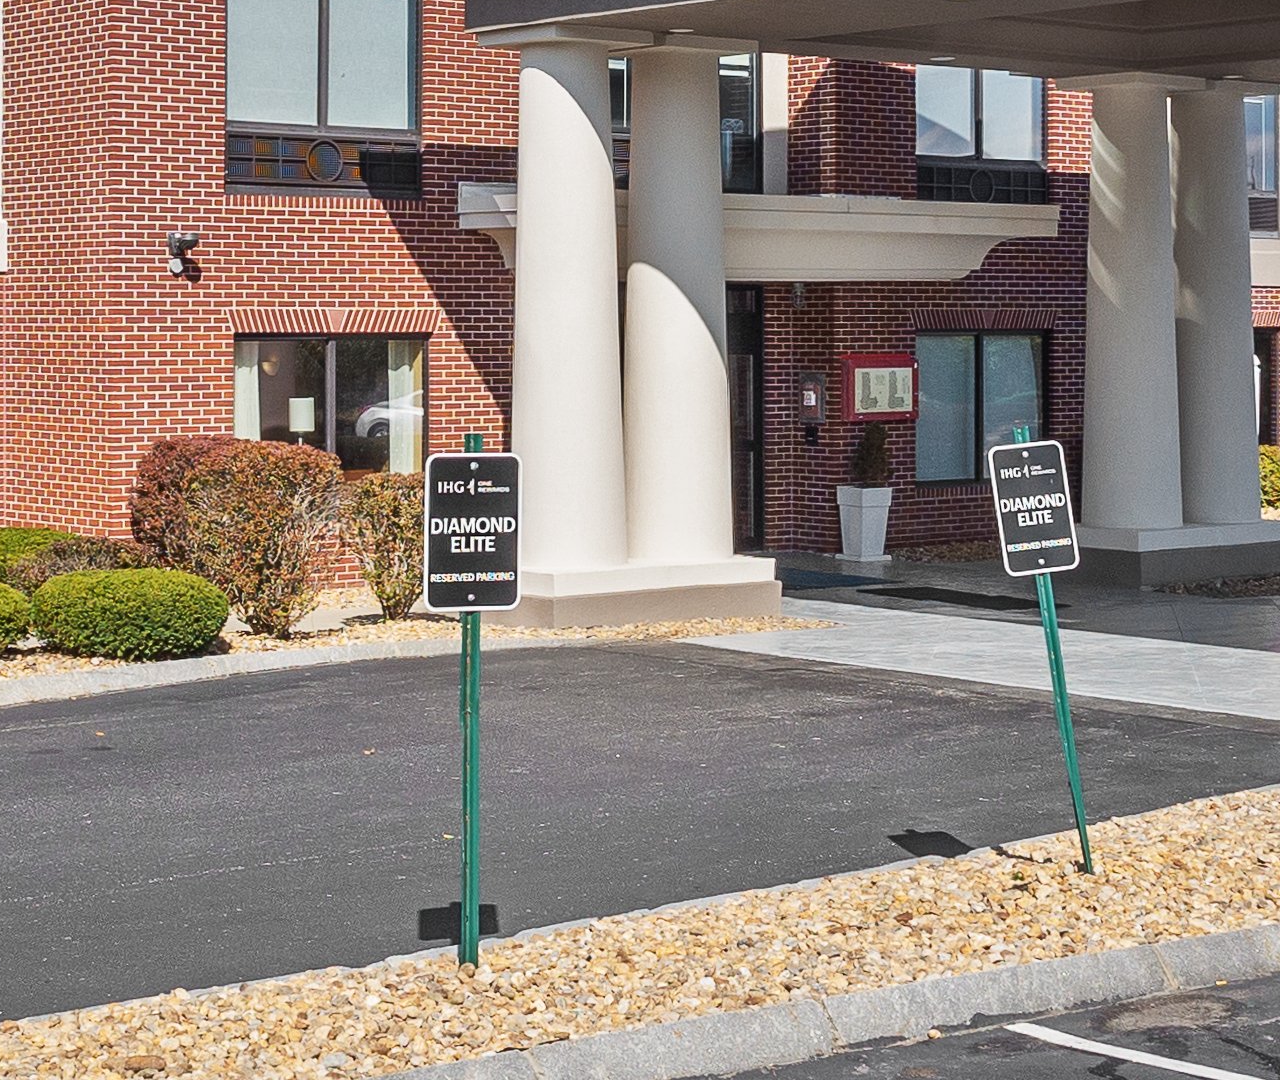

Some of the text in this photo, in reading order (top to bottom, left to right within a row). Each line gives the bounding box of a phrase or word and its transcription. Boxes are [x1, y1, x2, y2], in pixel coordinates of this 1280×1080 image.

[1000, 468, 1022, 480] IHG
[437, 480, 465, 494] IHG
[1000, 493, 1066, 513] DIAMOND
[430, 517, 517, 535] DIAMOND
[1017, 510, 1054, 527] ELITE
[450, 536, 497, 553] ELITE
[430, 571, 515, 583] RESERVED PARKING
